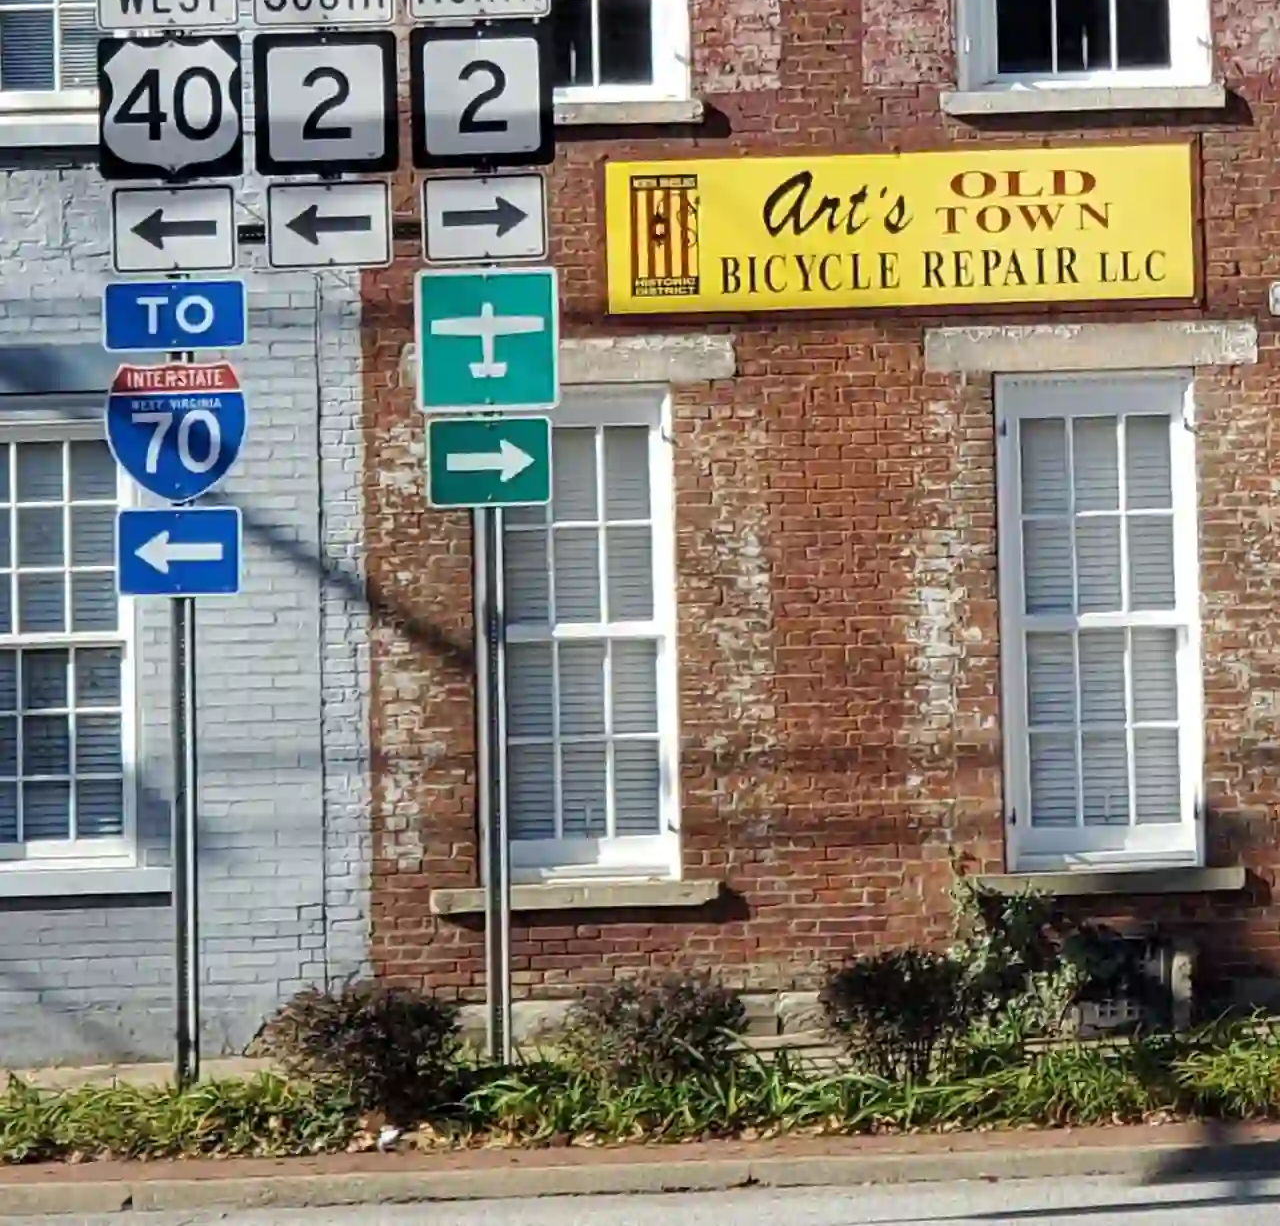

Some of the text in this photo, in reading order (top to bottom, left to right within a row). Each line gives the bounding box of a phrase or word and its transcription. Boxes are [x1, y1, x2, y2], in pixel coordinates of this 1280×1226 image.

[113, 66, 223, 141] 40
[301, 66, 353, 140] 2
[457, 59, 509, 134] 2
[763, 170, 914, 237] Art's
[950, 169, 1097, 199] OLD
[935, 202, 1113, 235] TOWN
[720, 246, 1167, 295] BICYCLE REPAIR LLC
[136, 294, 214, 335] TO
[127, 368, 225, 388] INTERSTATE
[169, 397, 222, 410] VIRGINIA
[131, 409, 221, 473] 70
